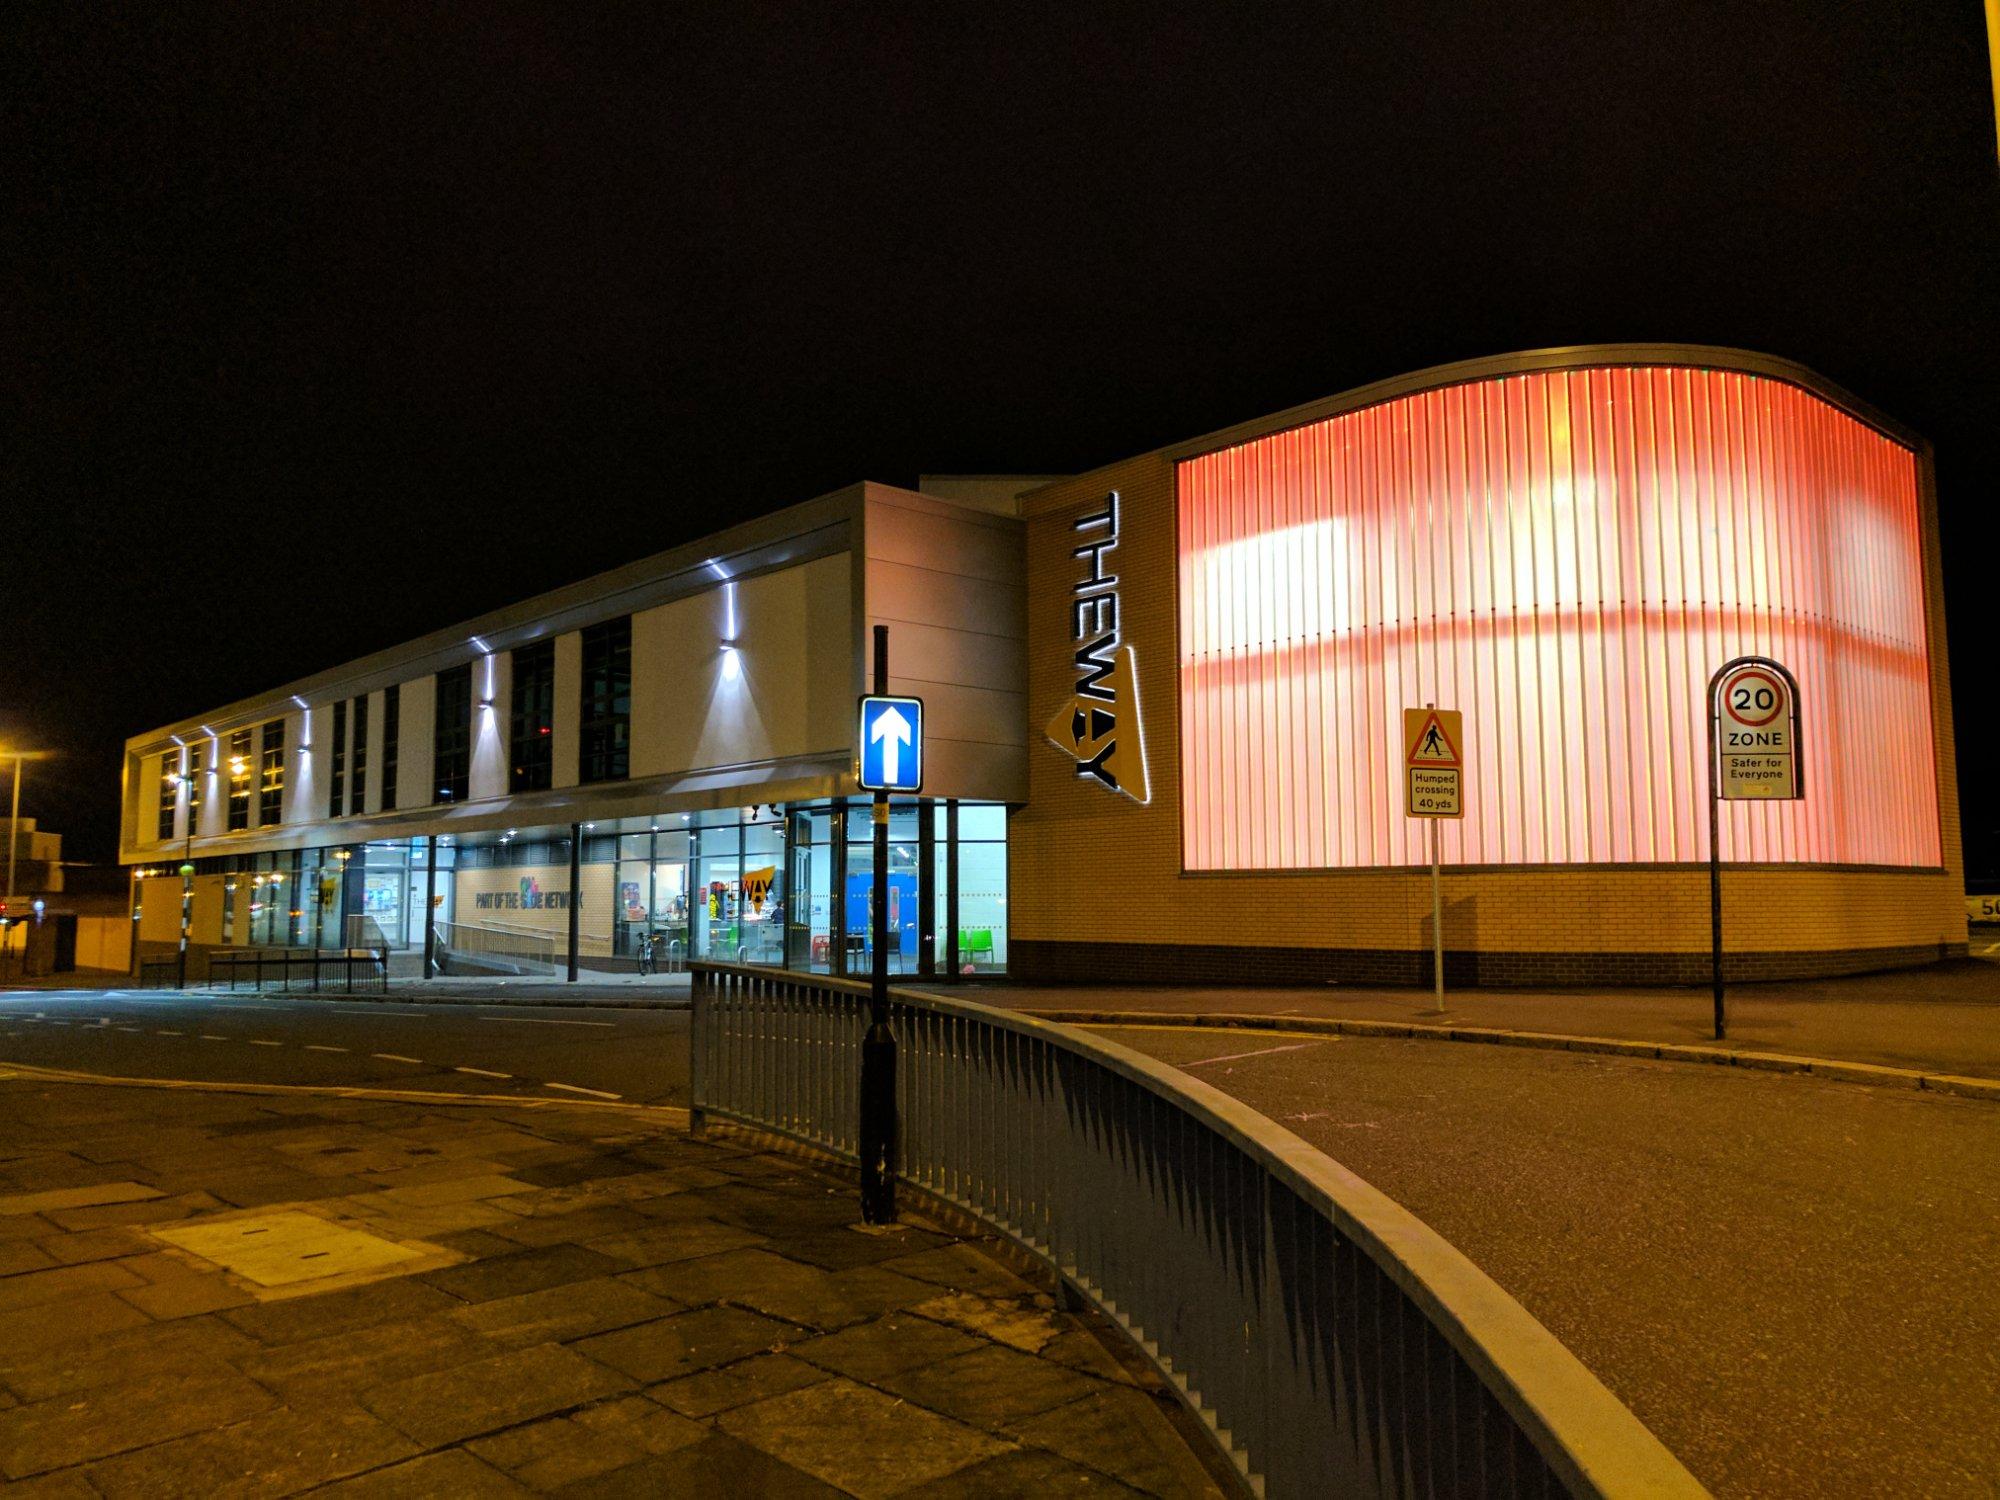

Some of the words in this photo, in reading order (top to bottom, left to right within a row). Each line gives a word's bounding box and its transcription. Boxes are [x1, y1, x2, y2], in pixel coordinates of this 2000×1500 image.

[1733, 688, 1774, 710] 20
[1728, 732, 1783, 746] ZONE
[1731, 758, 1761, 767] Safer
[1766, 758, 1782, 767] for
[1415, 773, 1455, 784] Humped
[1730, 769, 1783, 780] Everyone
[1415, 785, 1455, 796] crossing
[1419, 799, 1434, 808] 40
[1435, 800, 1452, 809] yds
[476, 892, 493, 909] PART
[494, 892, 504, 909] OF
[505, 892, 518, 909] THE
